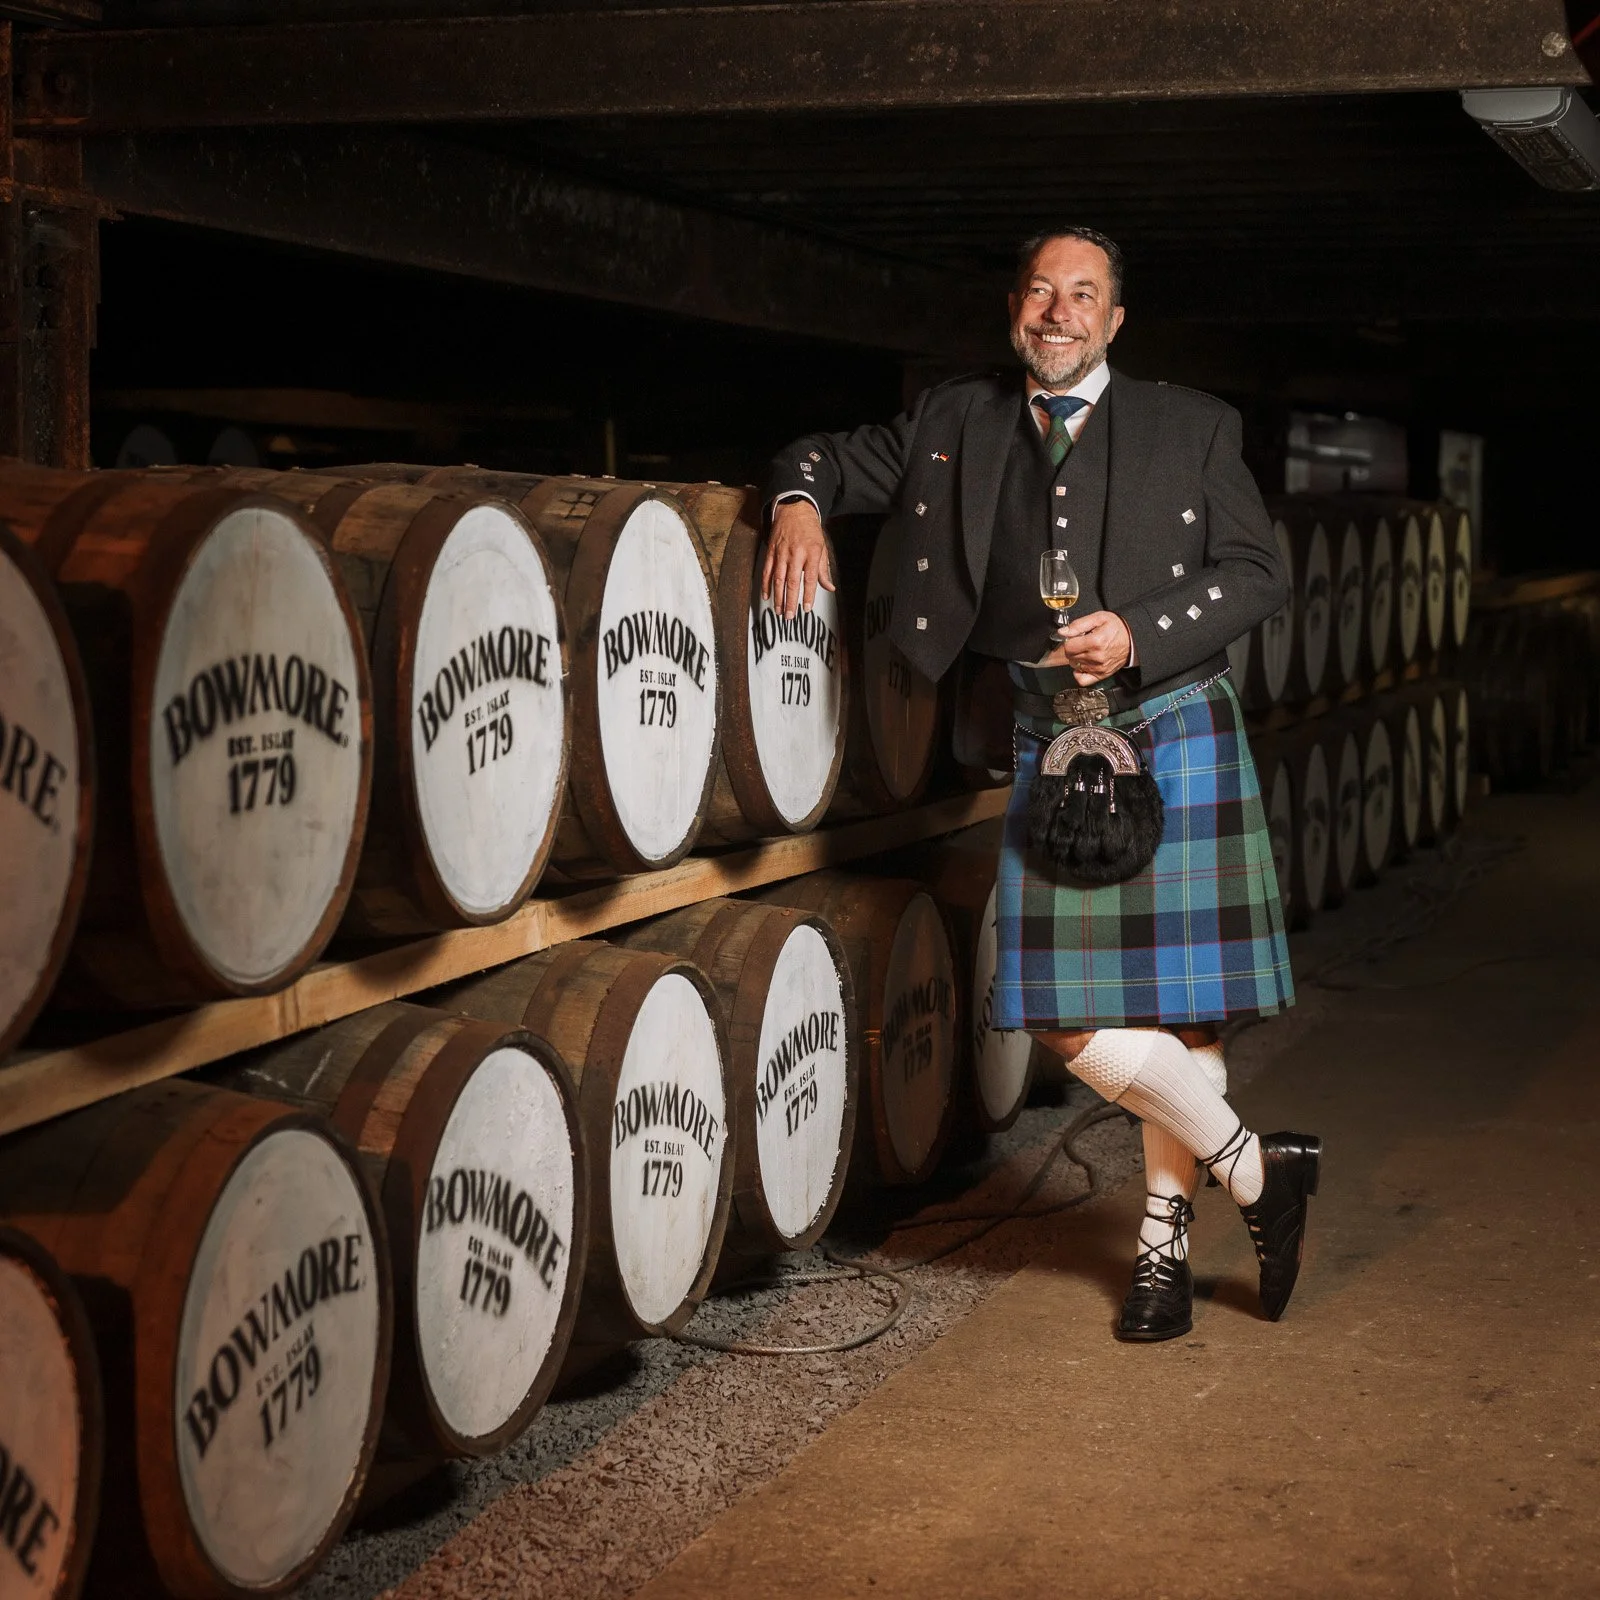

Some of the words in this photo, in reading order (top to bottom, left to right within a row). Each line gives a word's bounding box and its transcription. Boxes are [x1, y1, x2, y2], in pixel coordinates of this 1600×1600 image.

[602, 609, 710, 694] BOWMORE
[751, 603, 838, 672] BOWMORE
[780, 654, 793, 668] EST.
[794, 655, 810, 670] ISLAY
[162, 652, 350, 767] BOWMORE
[417, 625, 551, 753] BOWMORE
[464, 704, 485, 729] EST.
[486, 688, 510, 715] ISLAY
[639, 668, 656, 684] EST.
[658, 671, 677, 688] ISLAY
[639, 689, 677, 729] 1779
[781, 671, 811, 707] 1779
[227, 735, 257, 757] EST.
[262, 729, 295, 751] ISLAY
[465, 712, 514, 776] 1779
[227, 751, 298, 816] 1779
[756, 1011, 840, 1126] BOWMORE
[783, 1083, 798, 1103] EST.
[799, 1062, 817, 1087] ISLAY
[613, 1080, 719, 1161] BOWMORE
[785, 1079, 818, 1138] 1779
[641, 1158, 684, 1199] 1779
[643, 1139, 662, 1156] EST.
[664, 1141, 685, 1157] ISLAY
[425, 1167, 567, 1292] BOWMORE
[467, 1234, 485, 1258] EST.
[486, 1242, 515, 1271] ISLAY
[458, 1256, 512, 1320] 1779
[183, 1233, 363, 1461] BOWMORE
[255, 1364, 284, 1398] EST.
[285, 1321, 316, 1368] ISLAY
[259, 1343, 323, 1450] 1779
